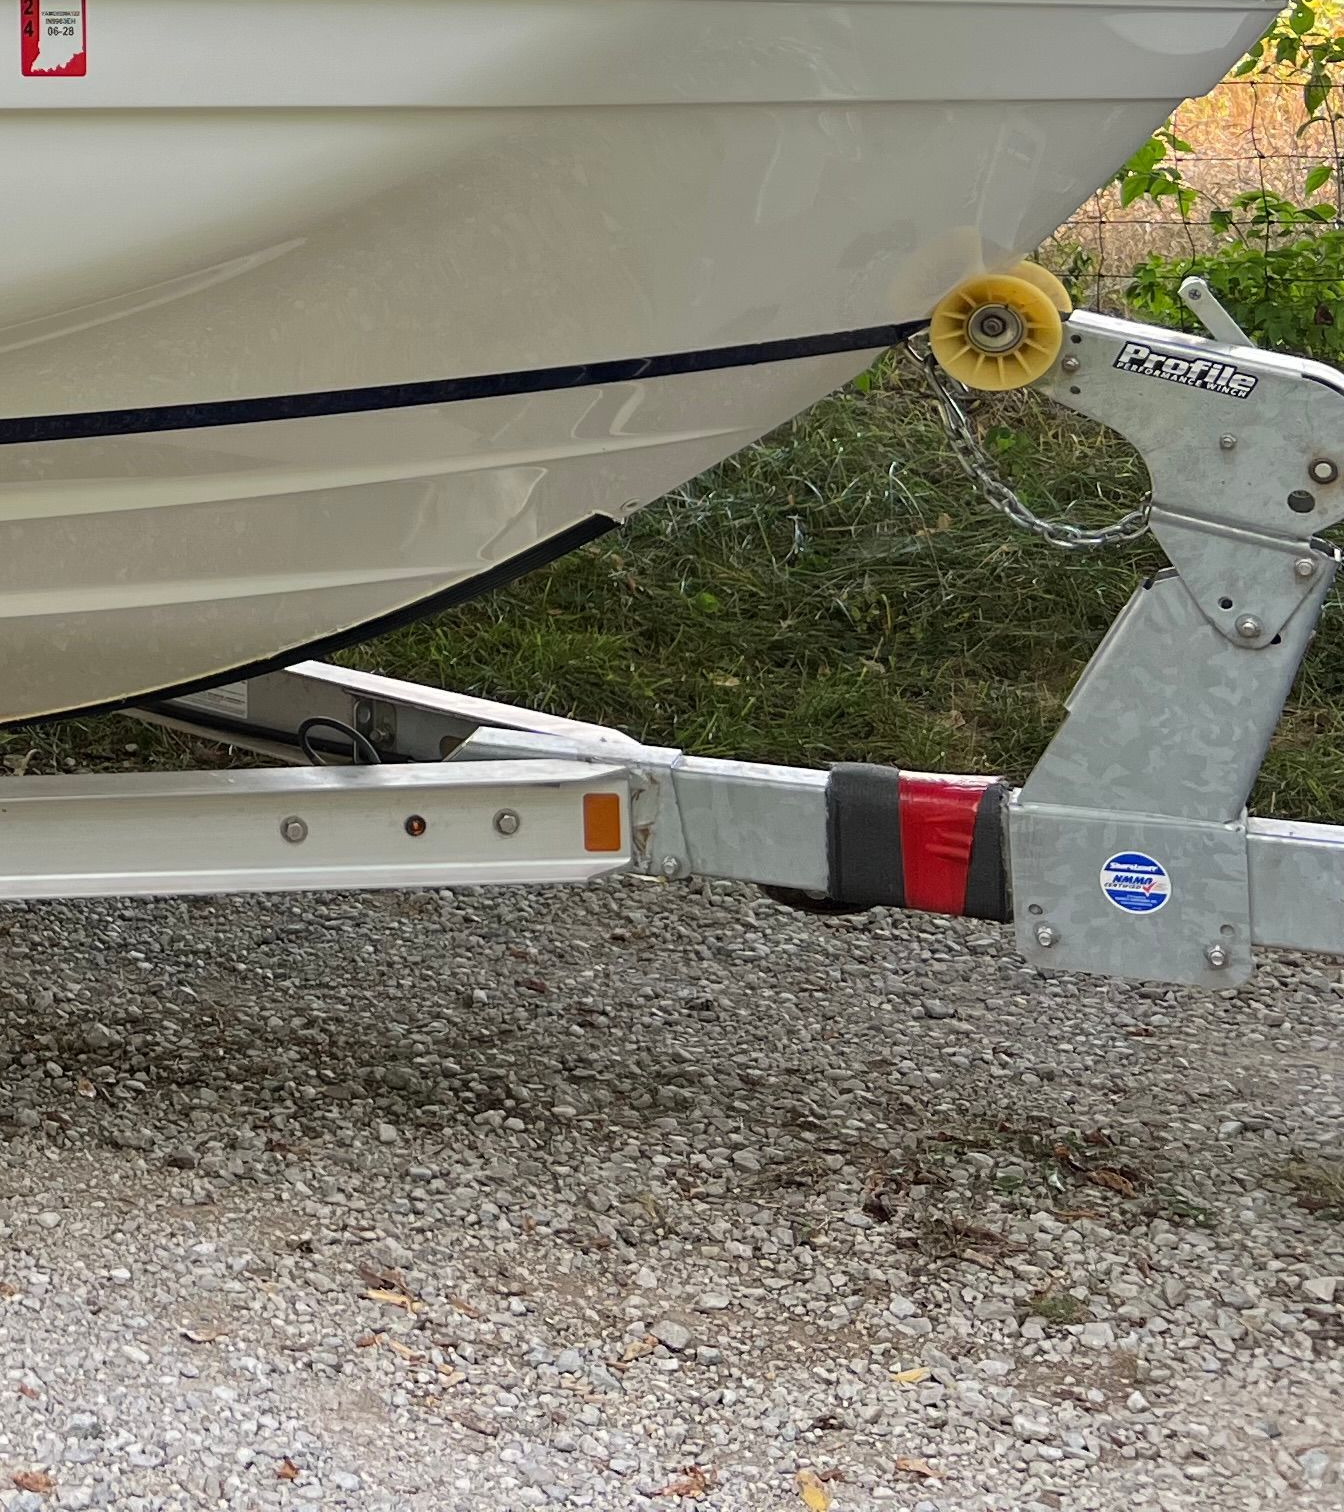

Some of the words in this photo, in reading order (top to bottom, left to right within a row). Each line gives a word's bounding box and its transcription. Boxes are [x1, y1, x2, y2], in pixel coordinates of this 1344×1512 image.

[47, 26, 75, 36] 06-28
[1116, 361, 1203, 387] PERFORMANCE
[1206, 382, 1248, 398] WINCH
[1118, 343, 1256, 392] Profile
